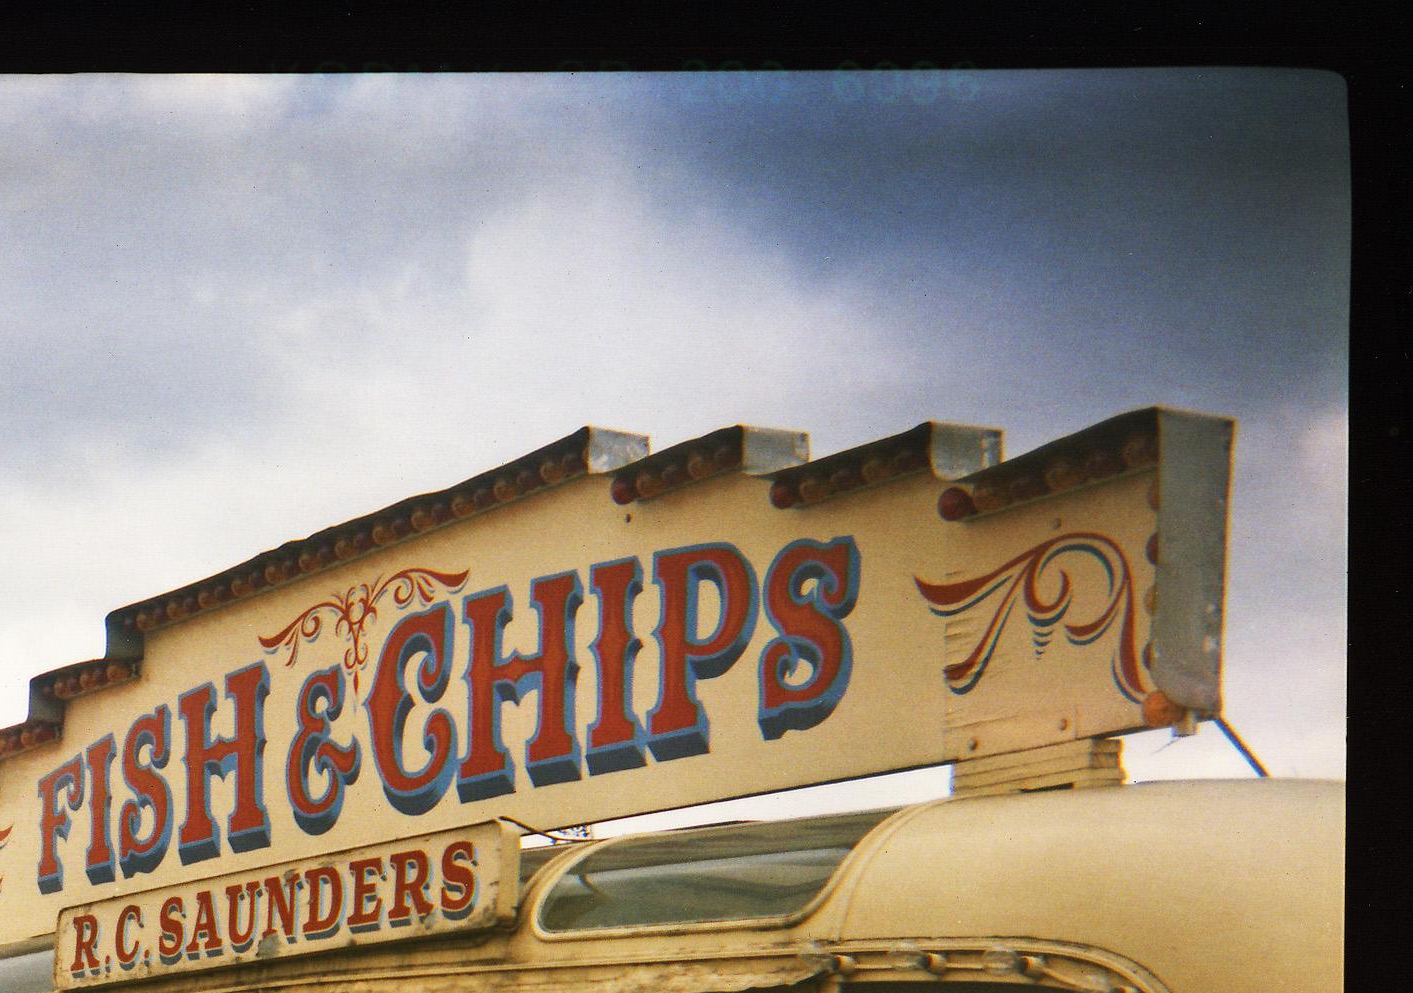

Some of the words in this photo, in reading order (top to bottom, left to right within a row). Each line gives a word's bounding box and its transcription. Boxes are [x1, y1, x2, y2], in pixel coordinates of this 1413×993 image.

[37, 661, 272, 896] FISH
[285, 663, 362, 836] &
[365, 535, 861, 817] CHIPS
